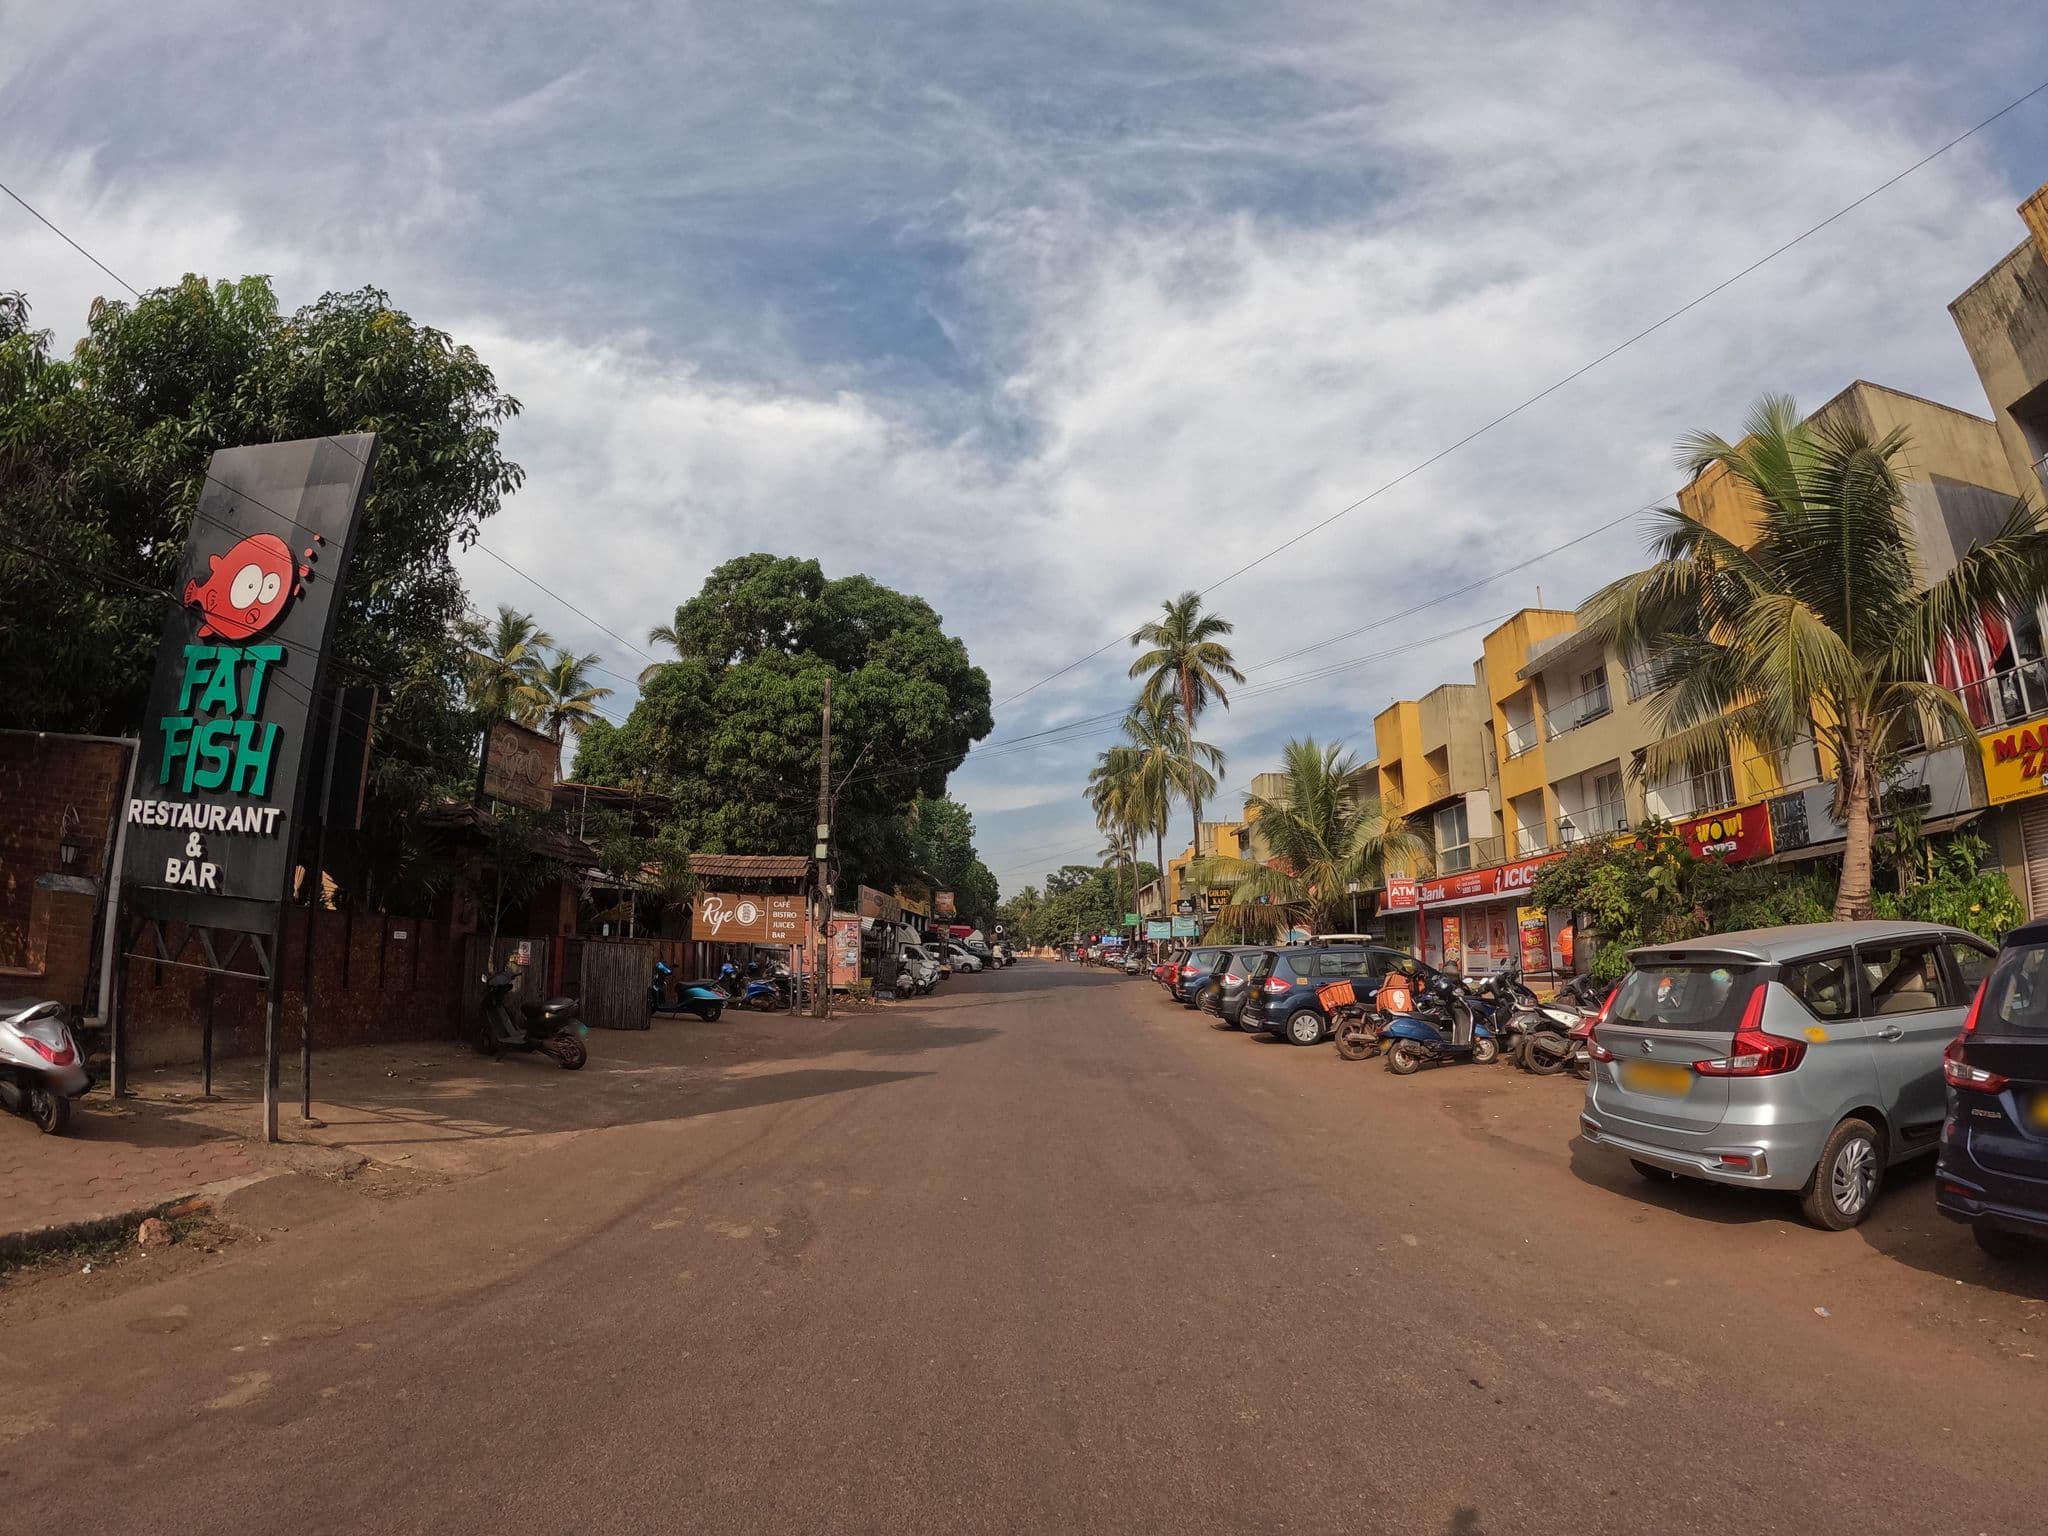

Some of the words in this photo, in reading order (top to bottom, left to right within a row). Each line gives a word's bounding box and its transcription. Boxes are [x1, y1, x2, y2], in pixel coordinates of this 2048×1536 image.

[178, 644, 282, 715] FAT
[160, 717, 277, 796] FISH
[128, 799, 280, 834] RESTAURANT
[1695, 812, 1744, 843] WOW!
[185, 831, 202, 858] &
[165, 857, 217, 889] BAR
[1391, 886, 1415, 896] ATM
[1420, 884, 1445, 901] Bank
[700, 897, 735, 936] Rye
